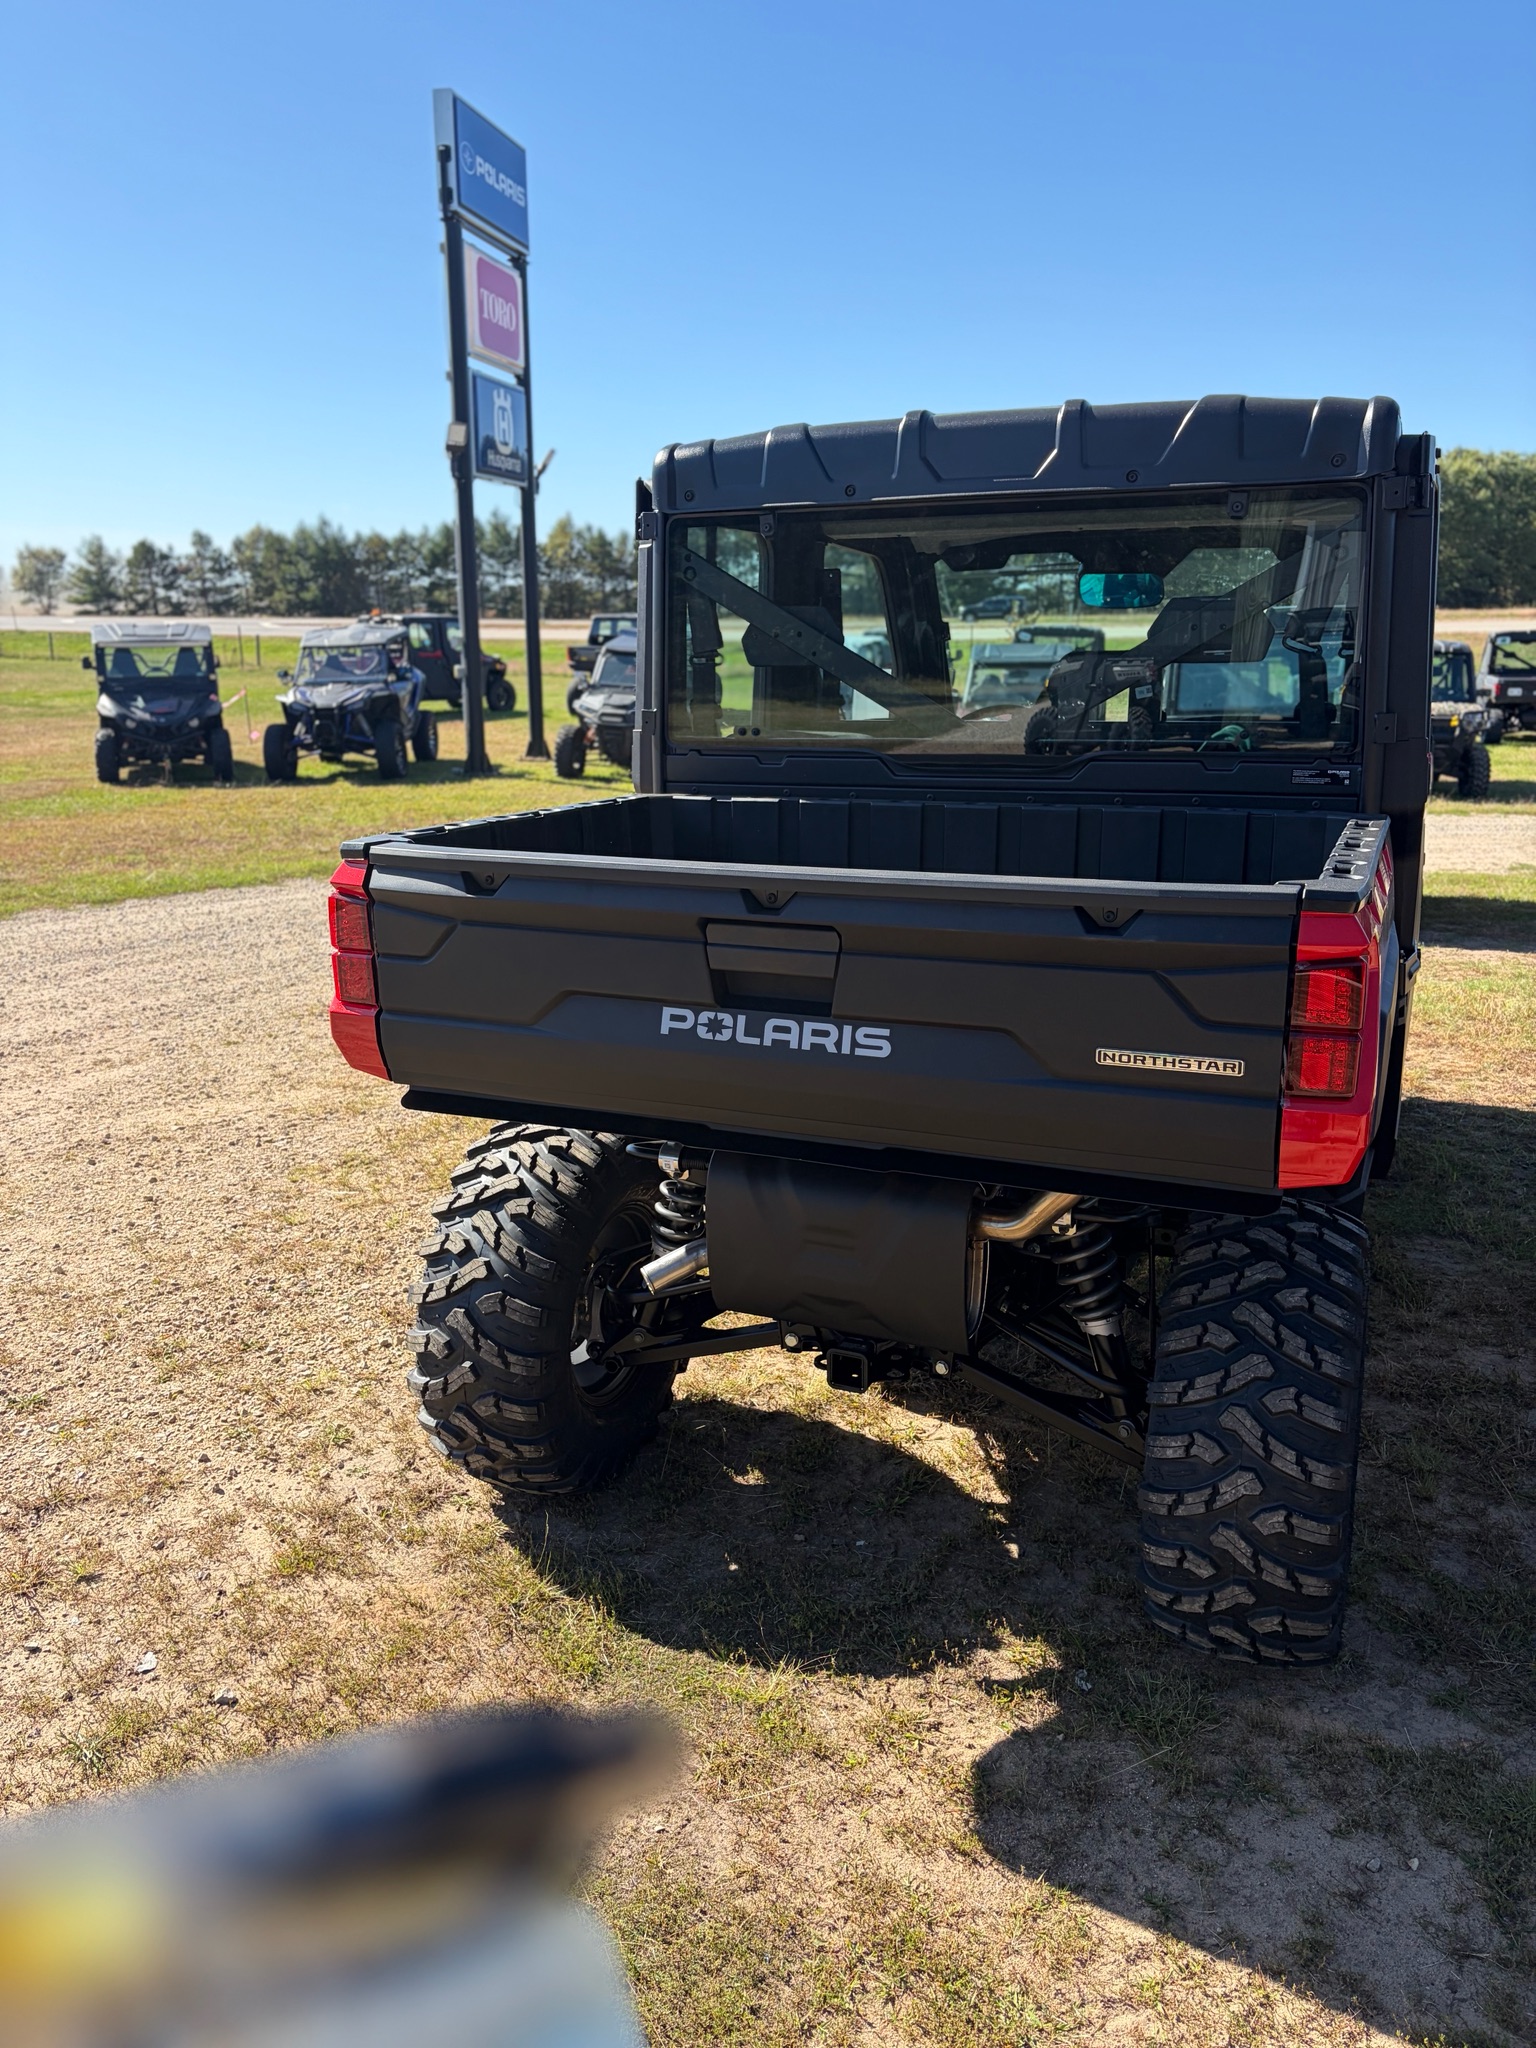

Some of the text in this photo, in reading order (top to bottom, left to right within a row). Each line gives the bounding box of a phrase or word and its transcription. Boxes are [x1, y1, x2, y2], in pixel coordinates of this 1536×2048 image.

[475, 154, 526, 208] POLARIS
[480, 287, 517, 332] TORO
[660, 1006, 892, 1058] POLARIS
[1102, 1052, 1237, 1073] NORTHSTAR
